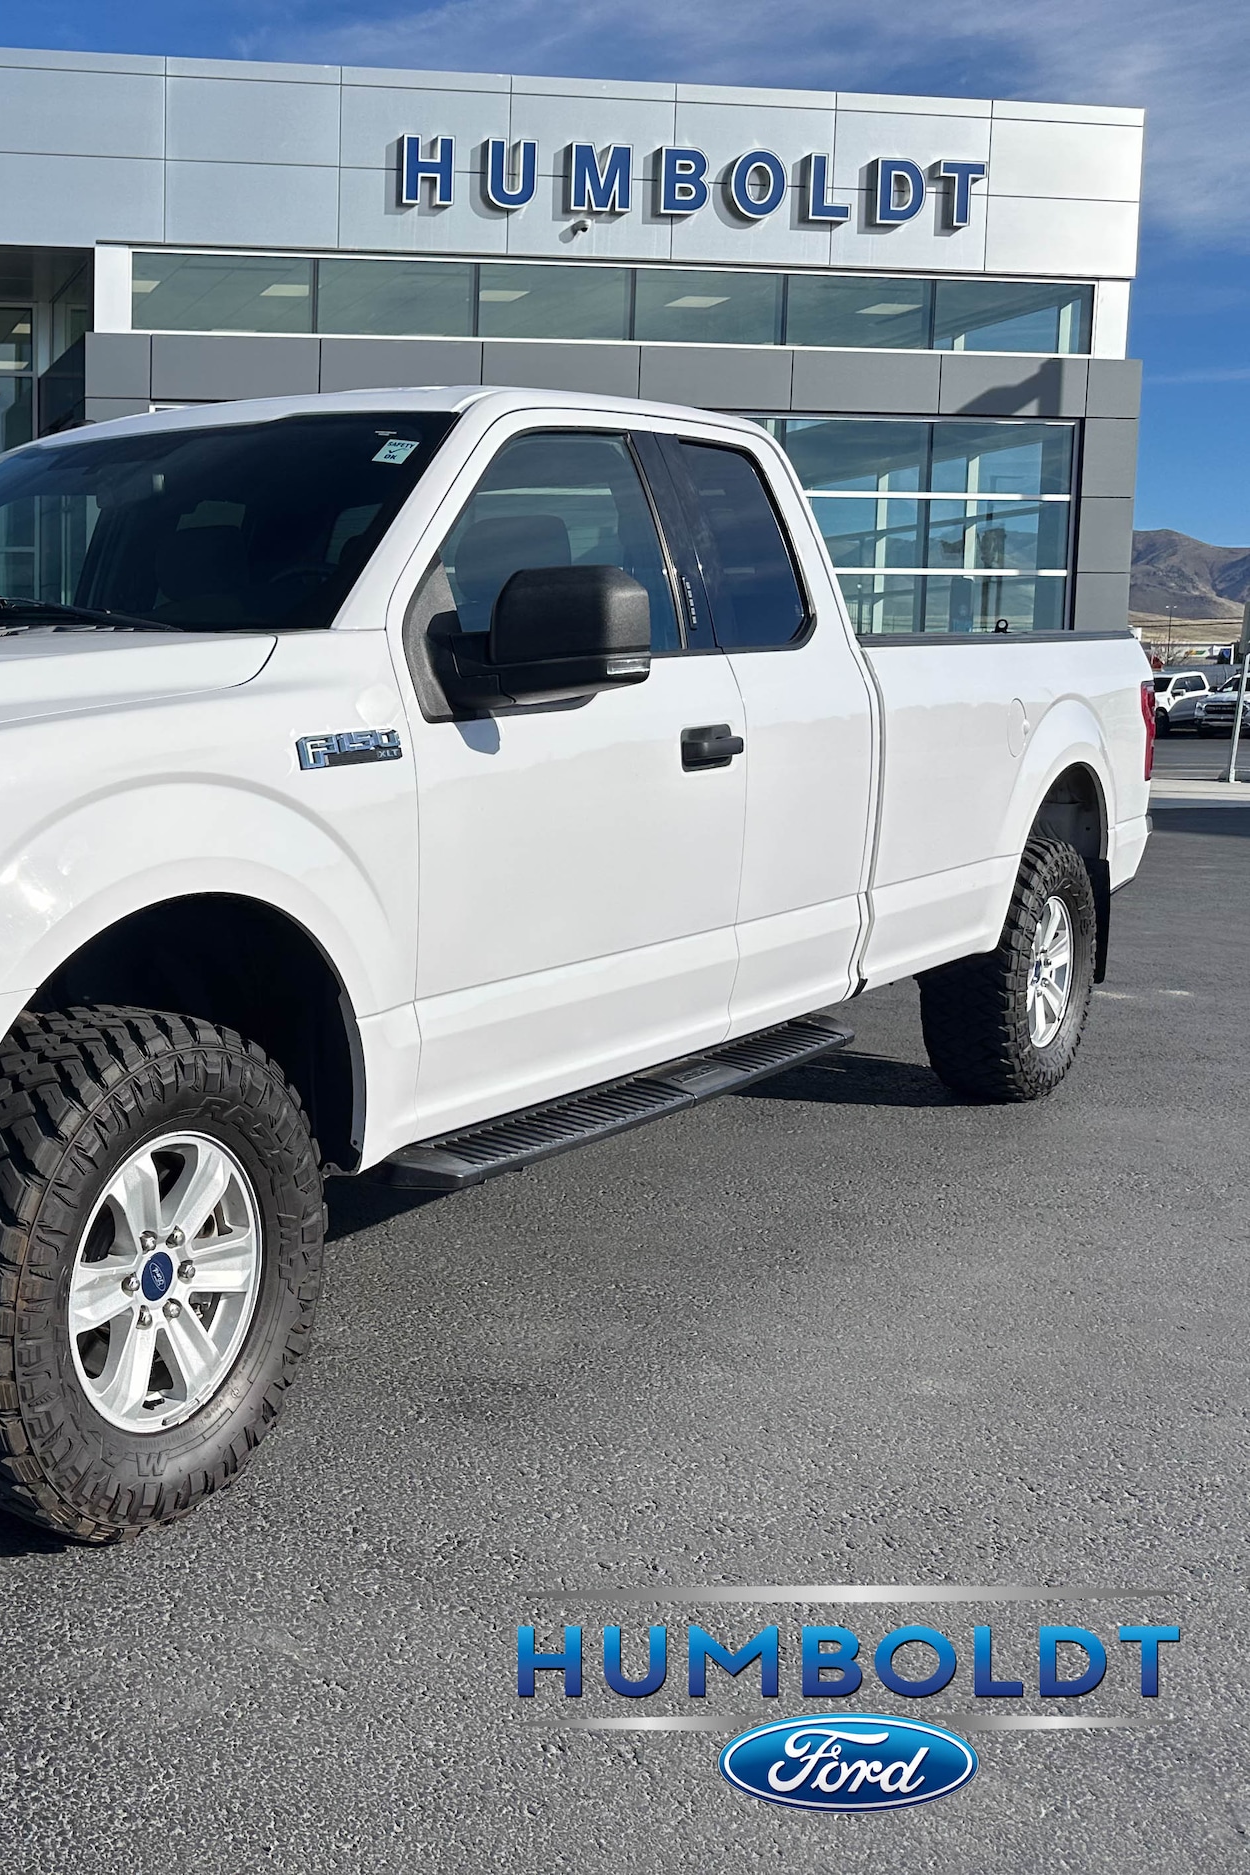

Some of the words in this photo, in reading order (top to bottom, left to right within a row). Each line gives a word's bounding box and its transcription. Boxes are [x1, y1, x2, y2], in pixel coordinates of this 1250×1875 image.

[400, 132, 989, 228] HUMBOLDT
[387, 441, 416, 449] SAFETY
[378, 748, 399, 759] XLT
